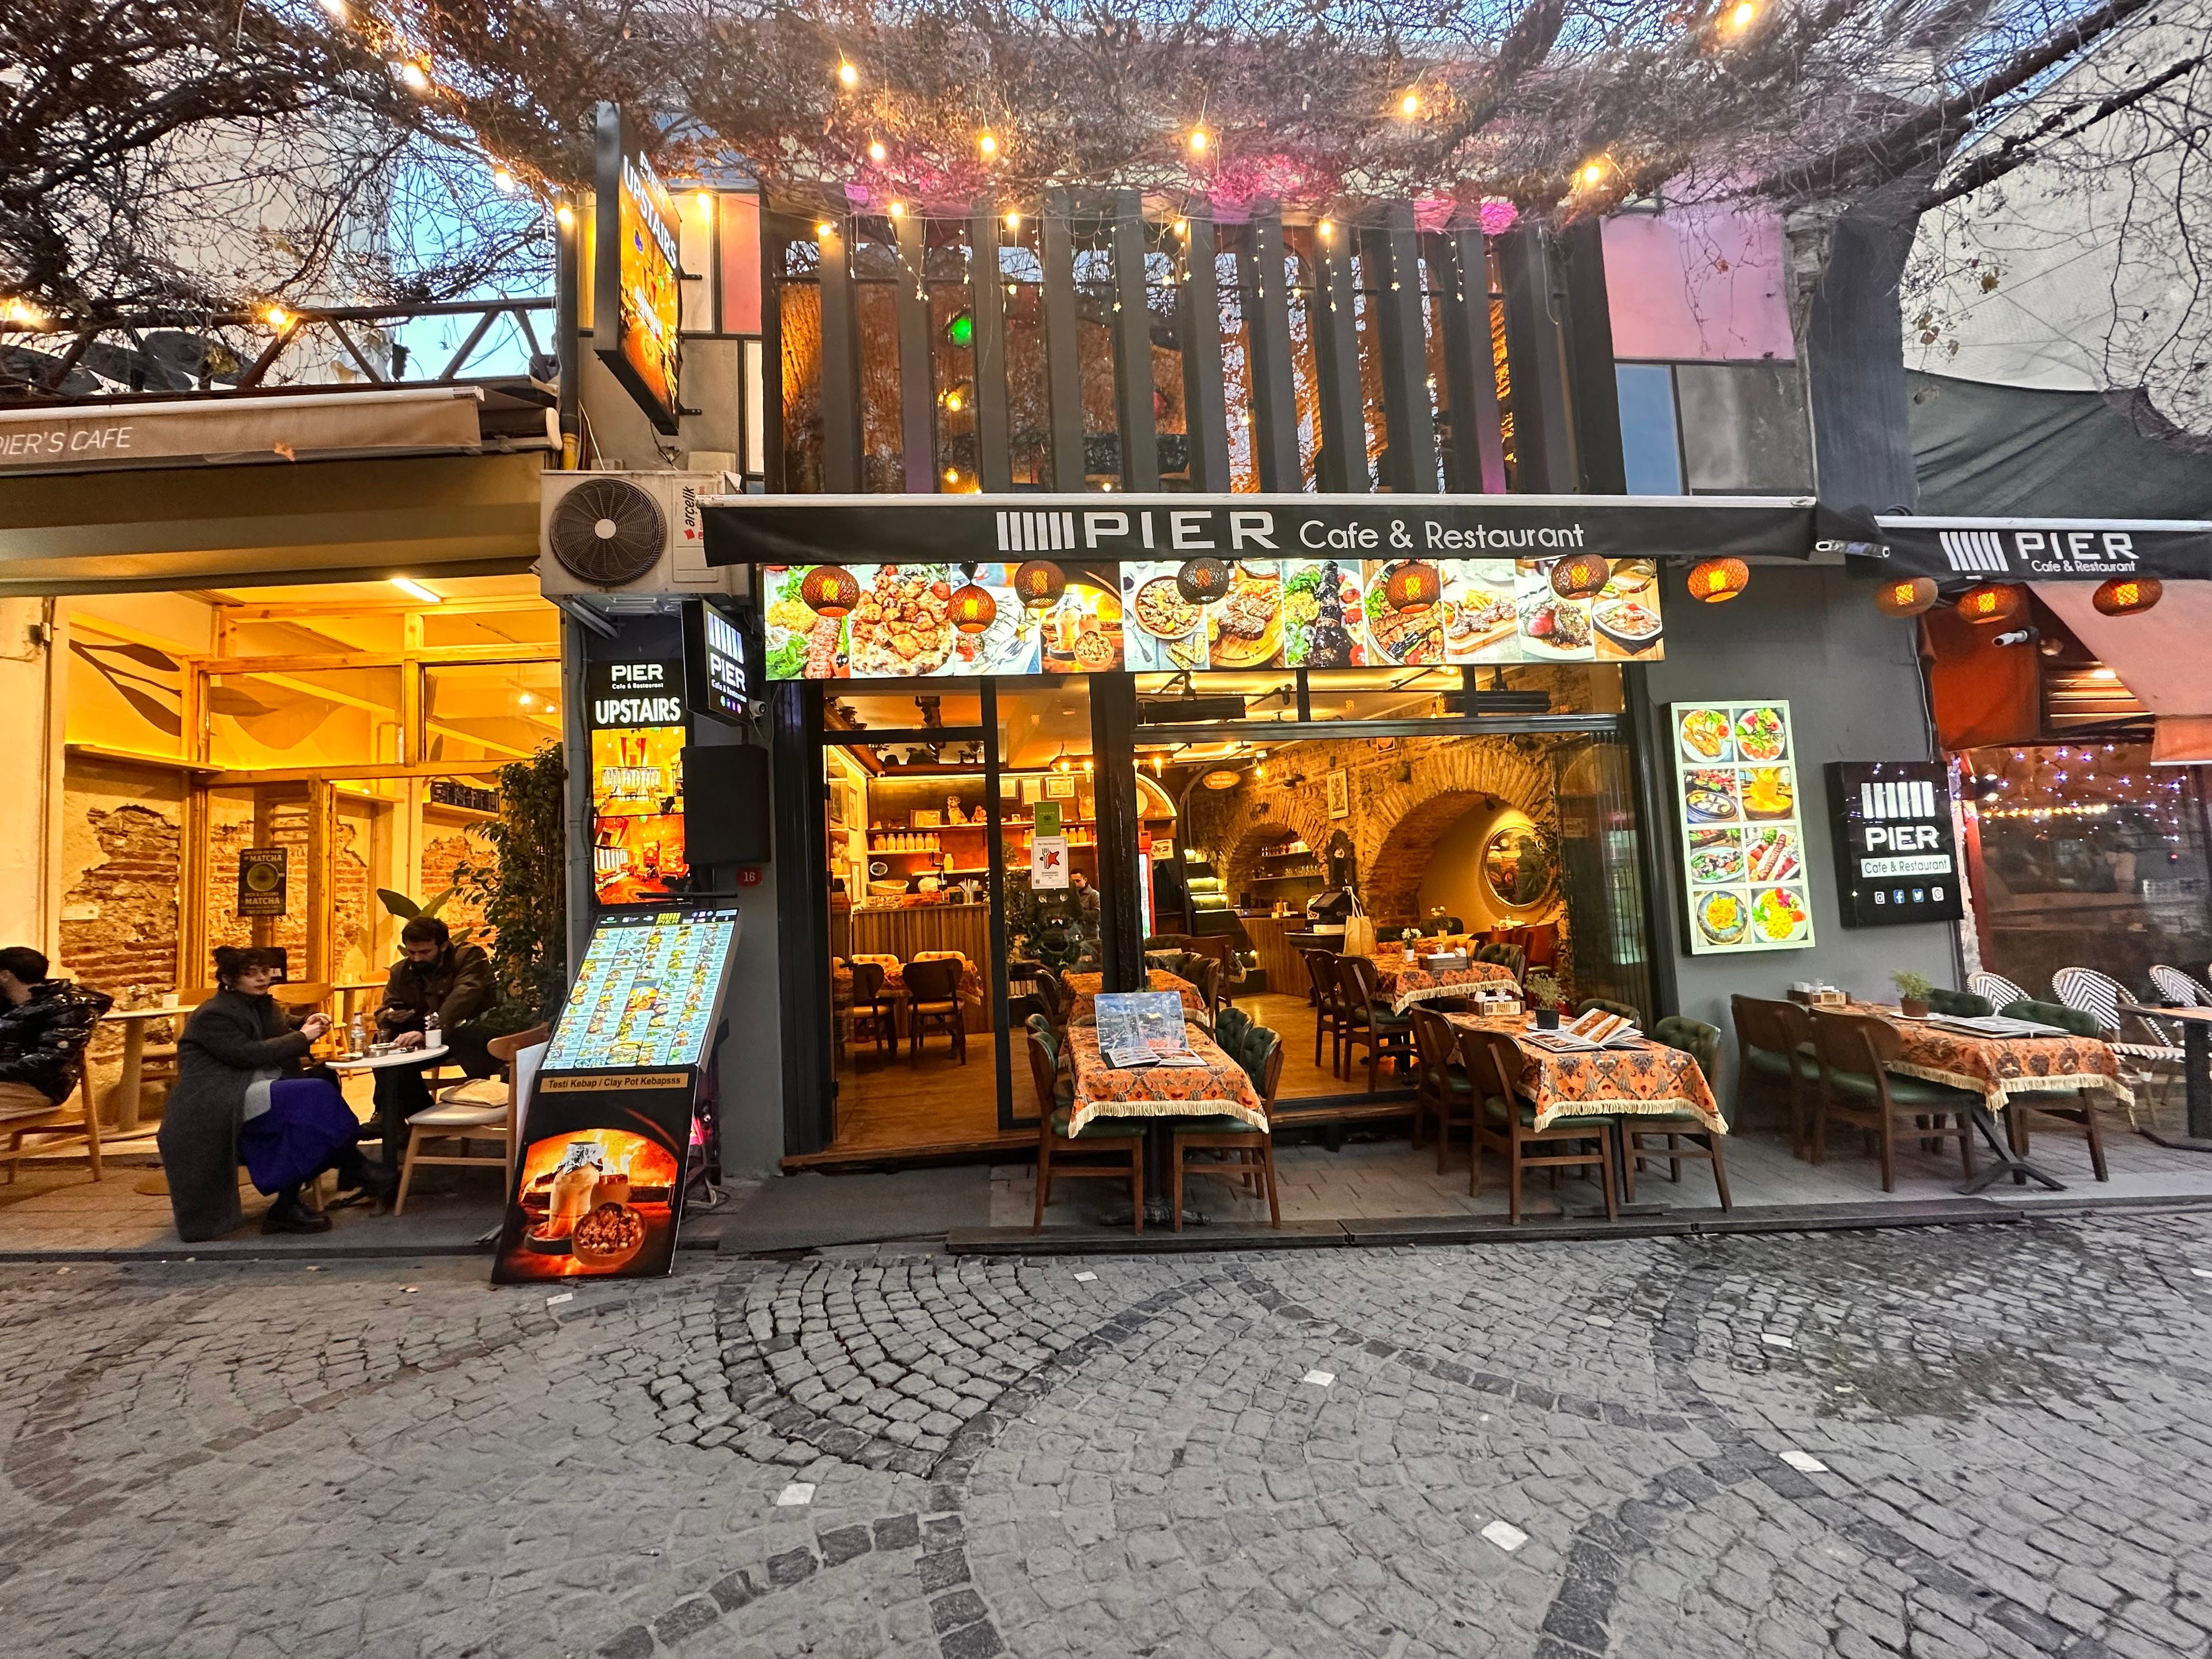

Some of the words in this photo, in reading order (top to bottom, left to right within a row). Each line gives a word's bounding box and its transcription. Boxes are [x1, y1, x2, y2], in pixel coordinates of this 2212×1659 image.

[623, 154, 677, 270] UPSTAIRS
[71, 426, 134, 450] CAFE
[682, 486, 698, 527] arçelik
[1084, 511, 1281, 550] PIER
[1299, 519, 1379, 550] Cafe
[1389, 519, 1414, 549] &
[1425, 520, 1585, 550] Restaurant
[2015, 532, 2140, 560] PIER
[2031, 560, 2061, 573] Cafe
[2063, 560, 2074, 572] &
[2075, 560, 2136, 573] Restaurant
[611, 664, 664, 681] PIER
[709, 652, 747, 692] PIER
[594, 696, 681, 725] UPSTAIRS
[1865, 825, 1939, 851] PIER
[744, 872, 755, 882] 16
[1865, 862, 1888, 874] Cafe
[1891, 861, 1897, 872] &
[1899, 859, 1947, 872] Restaurant
[245, 897, 281, 905] MATCHA
[548, 1078, 568, 1089] Testi
[570, 1078, 597, 1089] Kebap
[599, 1078, 603, 1086] /
[604, 1078, 623, 1088] Clay
[624, 1077, 639, 1086] Pot
[641, 1076, 681, 1086] Kebapsss
